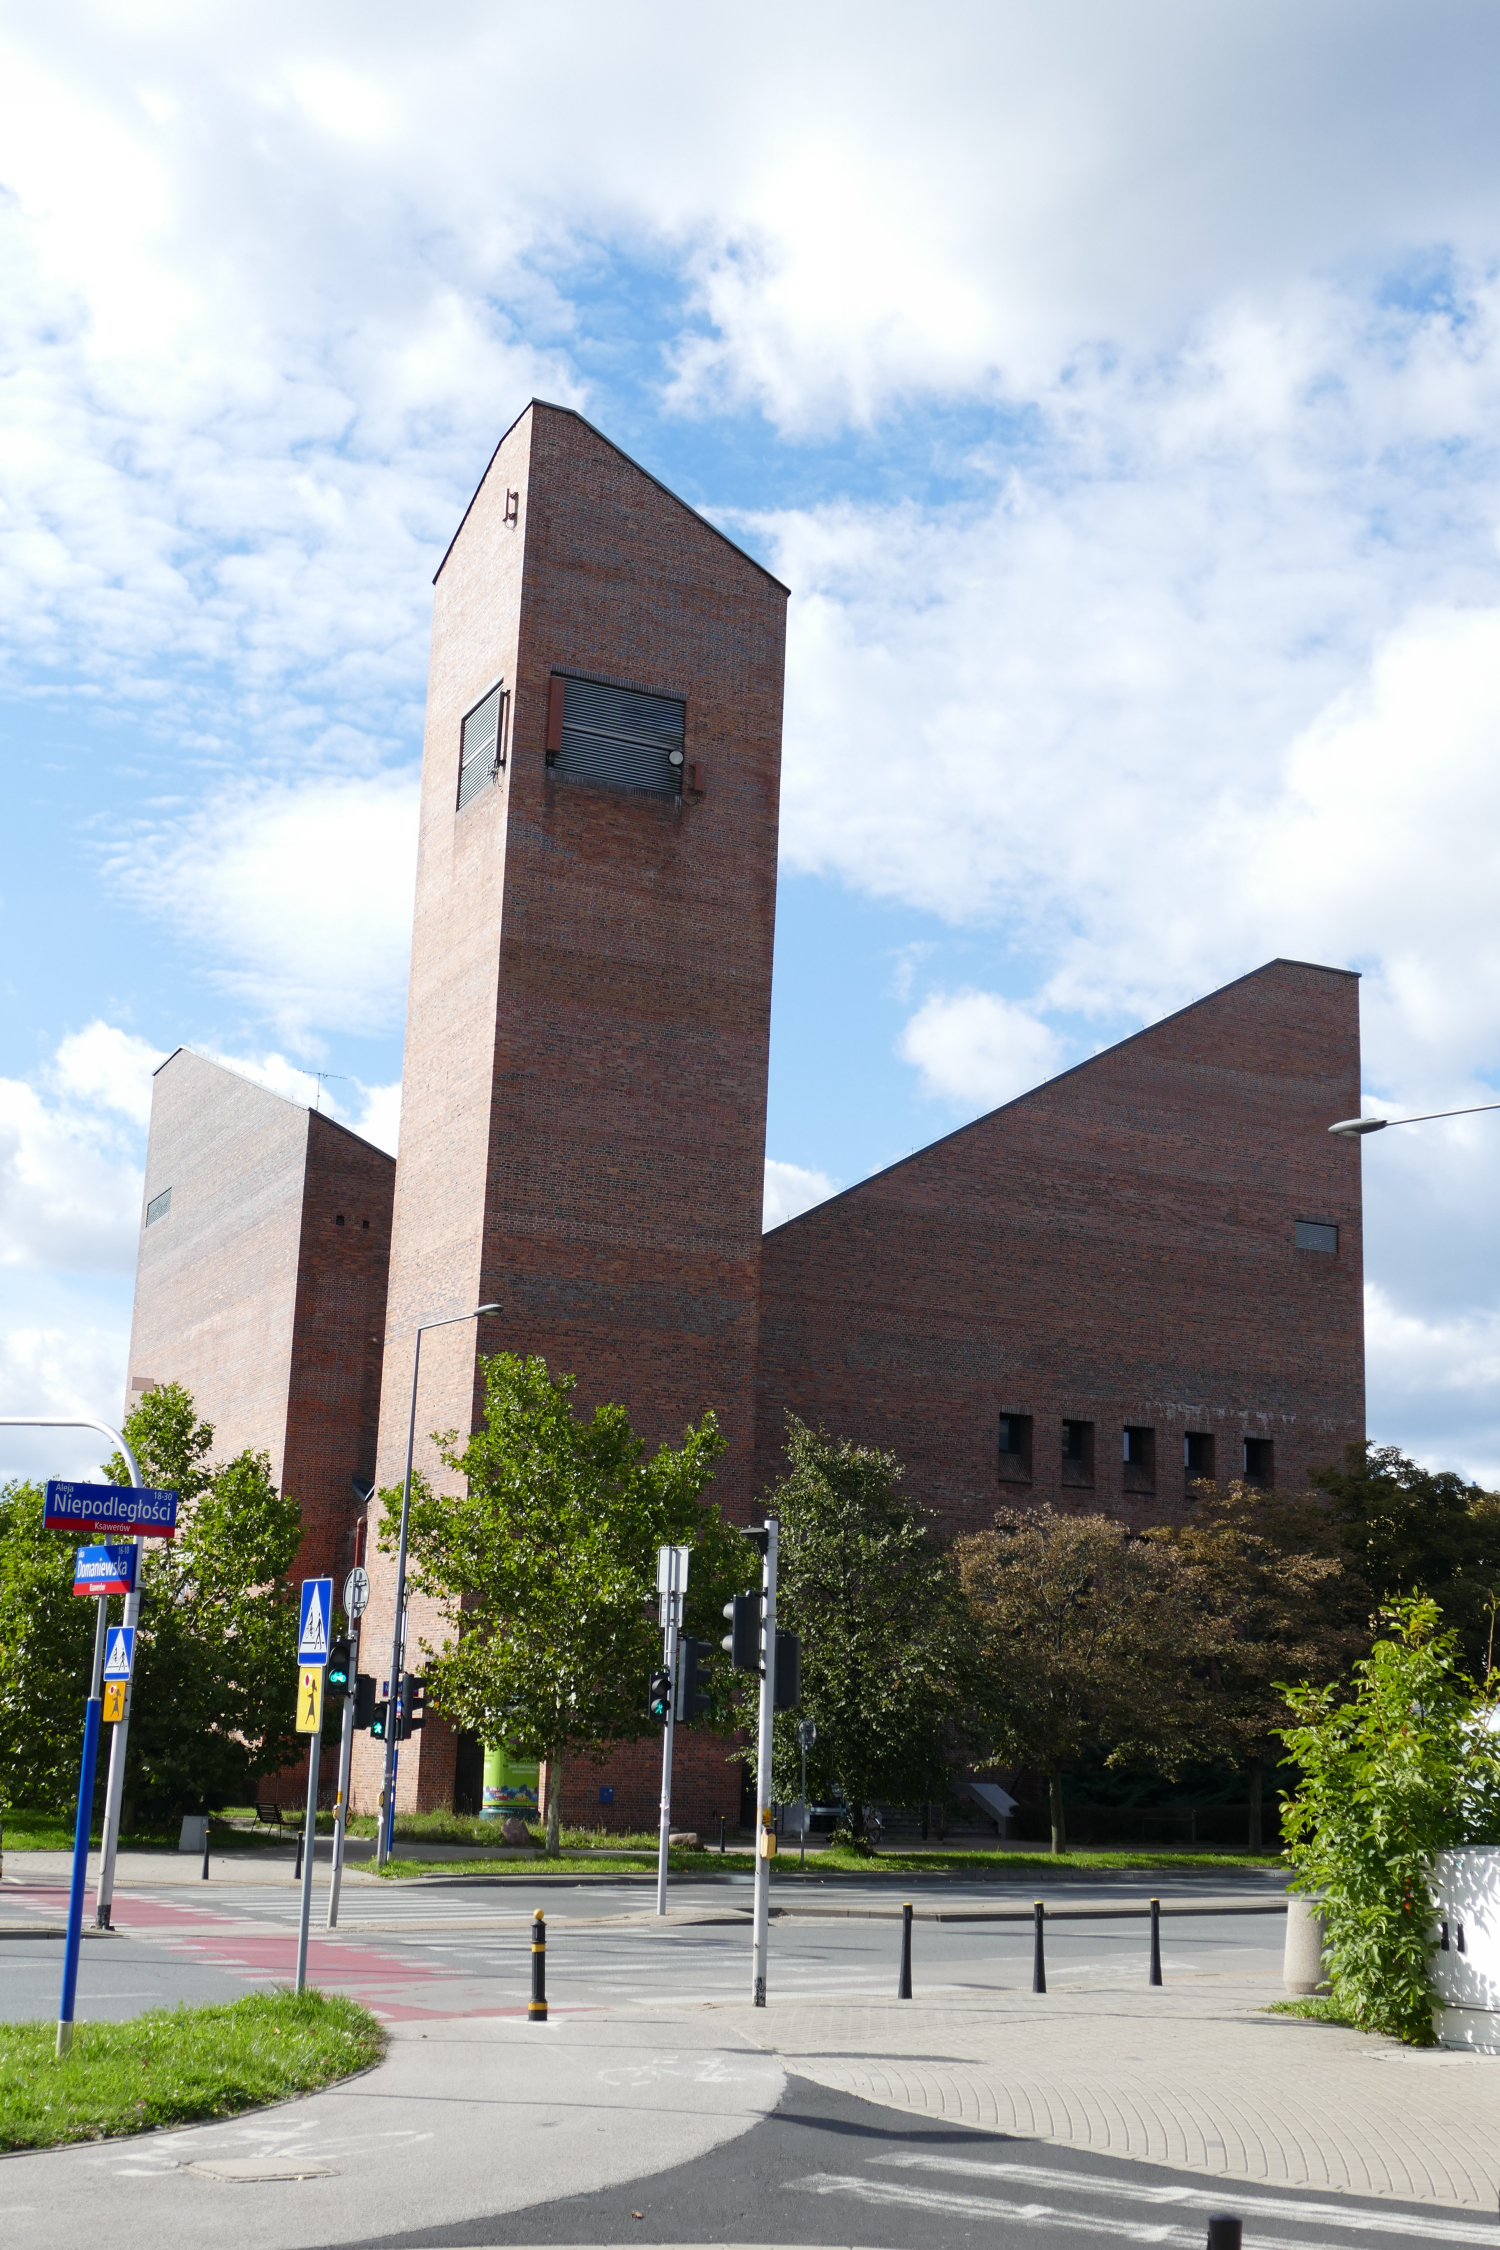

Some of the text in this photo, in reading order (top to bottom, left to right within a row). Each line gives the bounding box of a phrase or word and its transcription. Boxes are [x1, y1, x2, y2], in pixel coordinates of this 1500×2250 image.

[55, 1483, 74, 1494] Aleja
[153, 1491, 173, 1502] 18-30
[54, 1493, 171, 1523] Niepodległości
[94, 1521, 131, 1532] Ksawerów
[77, 1556, 127, 1578] Domaniewska
